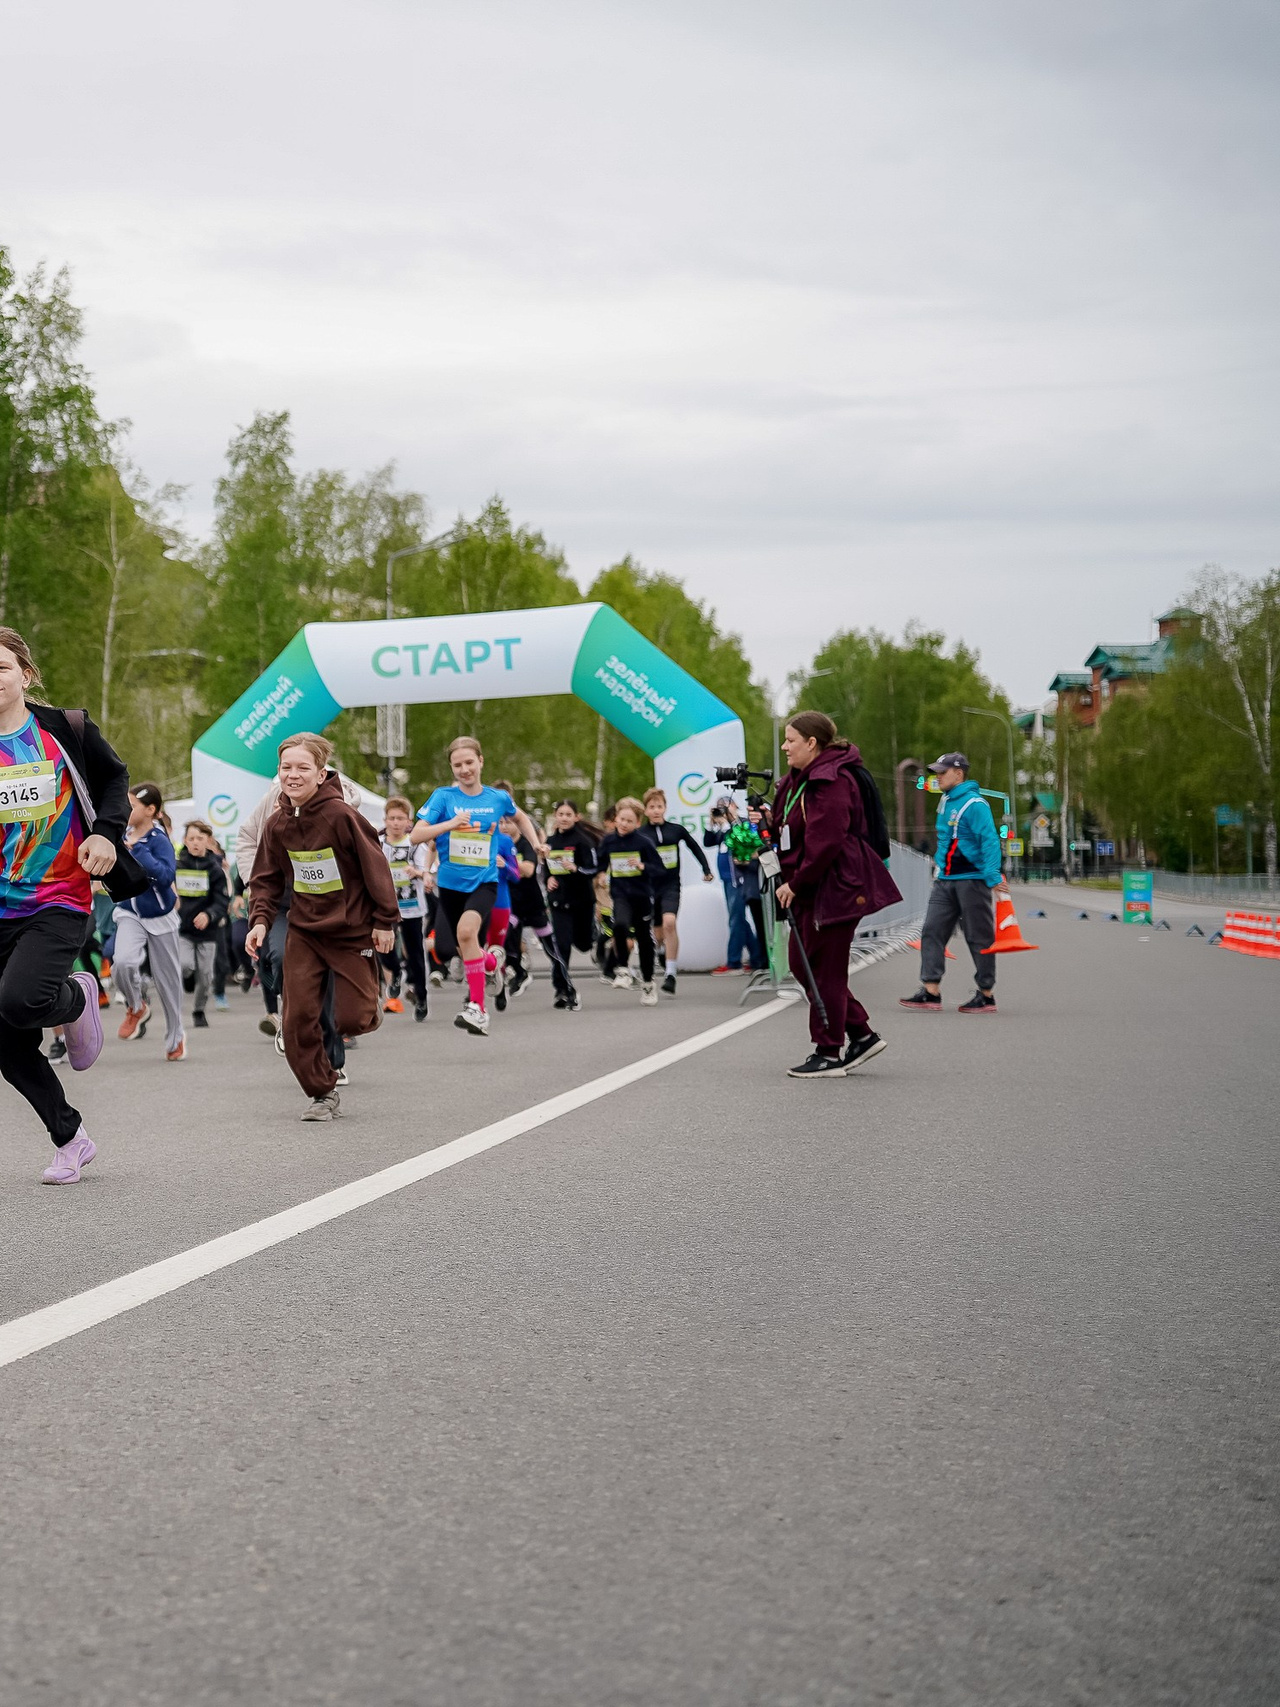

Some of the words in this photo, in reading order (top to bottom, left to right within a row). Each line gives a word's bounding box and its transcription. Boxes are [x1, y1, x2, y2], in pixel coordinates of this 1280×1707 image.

[371, 637, 522, 679] СТАРТ
[594, 666, 664, 728] марафон
[243, 687, 305, 751] марафон
[0, 787, 39, 805] 3145
[300, 868, 325, 880] 3088
